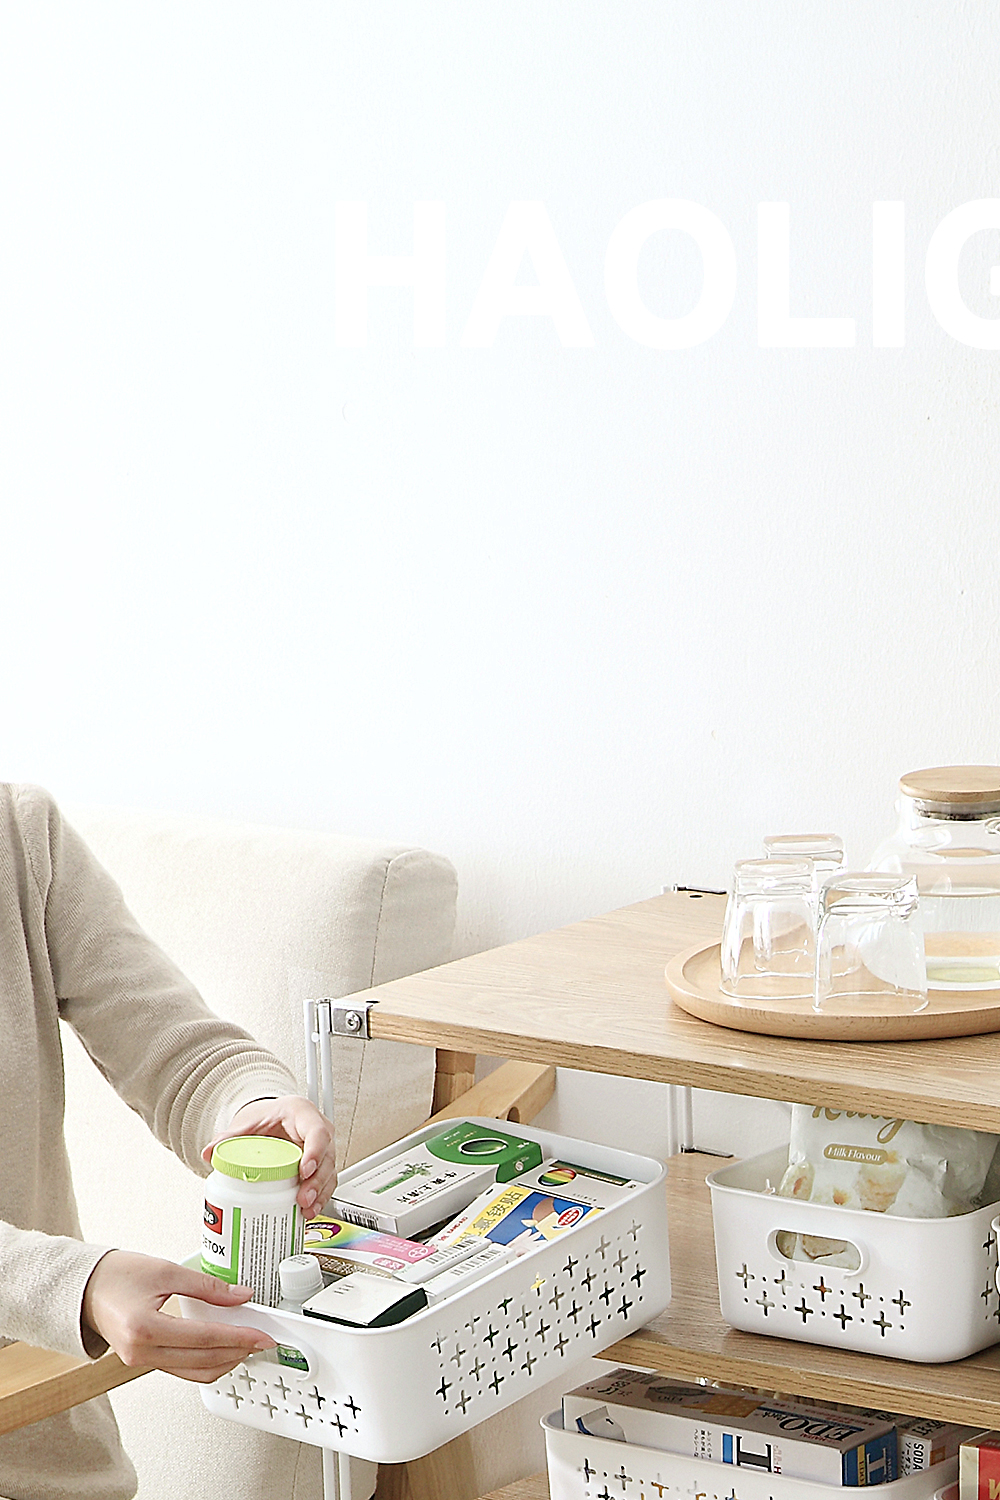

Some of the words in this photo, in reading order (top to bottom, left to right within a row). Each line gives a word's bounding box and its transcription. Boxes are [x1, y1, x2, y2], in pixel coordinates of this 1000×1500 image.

[828, 1146, 847, 1158] Milk
[848, 1149, 882, 1162] Flavour
[778, 1417, 860, 1442] EDO
[912, 1442, 925, 1471] SODA
